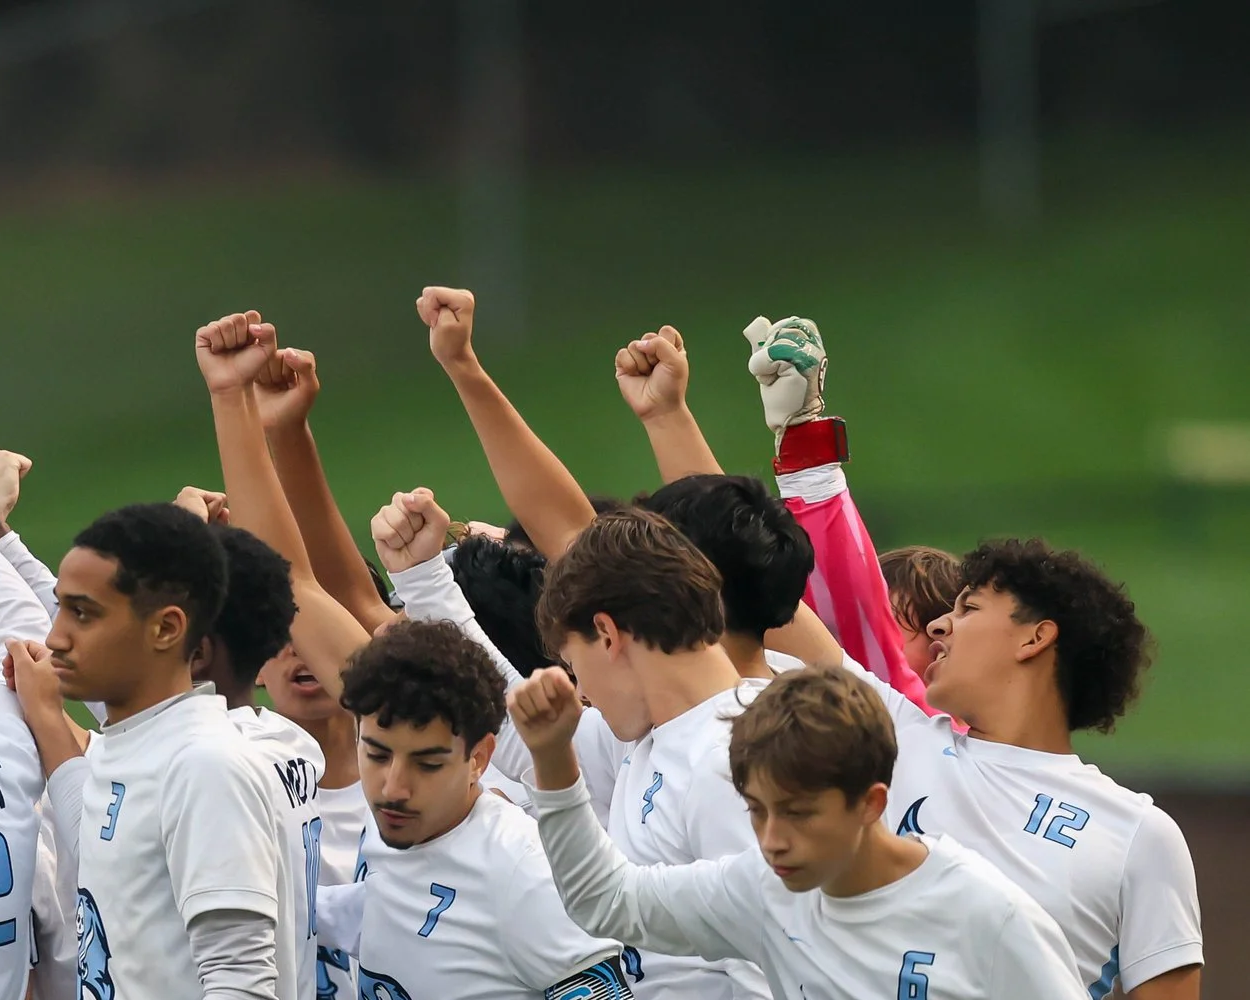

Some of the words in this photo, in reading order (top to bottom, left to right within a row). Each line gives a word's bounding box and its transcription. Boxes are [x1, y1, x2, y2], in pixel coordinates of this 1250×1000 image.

[100, 781, 126, 842] 3
[1023, 793, 1090, 849] 12
[417, 882, 457, 938] 7
